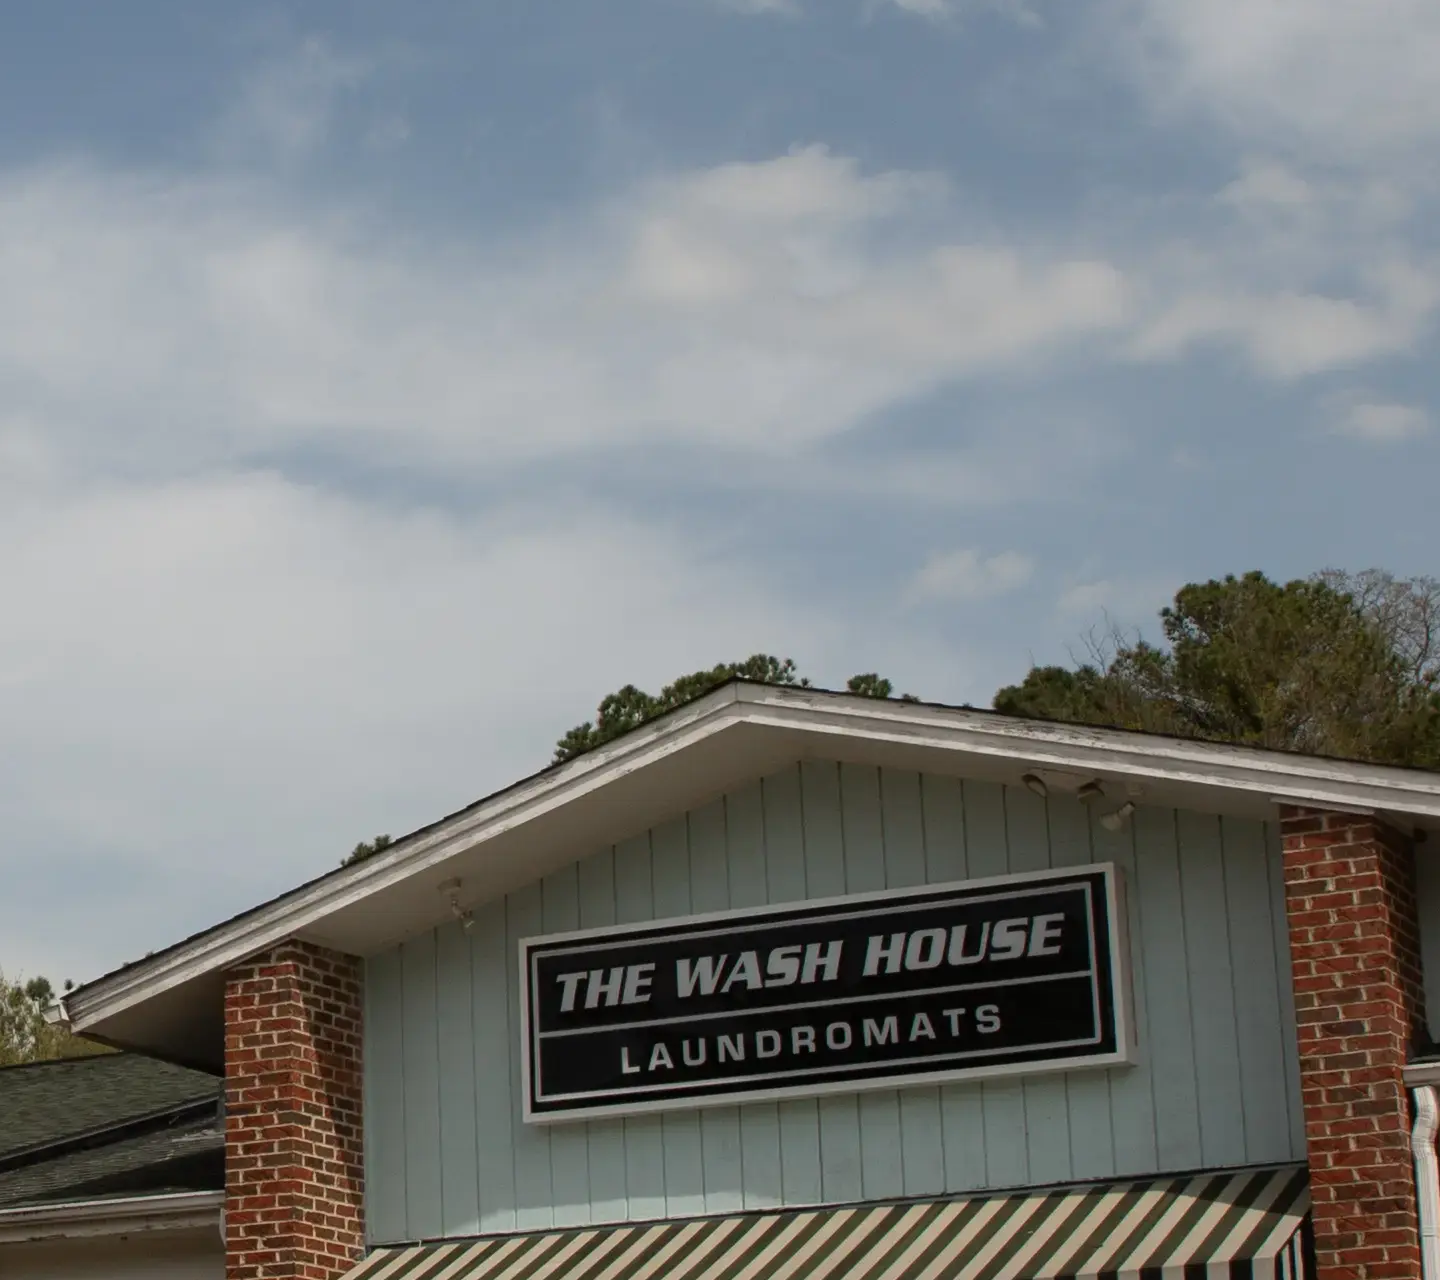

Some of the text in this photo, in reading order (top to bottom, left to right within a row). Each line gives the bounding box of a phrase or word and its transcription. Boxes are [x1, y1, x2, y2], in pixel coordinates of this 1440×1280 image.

[554, 912, 1066, 1012] THE WASH HOUSE
[620, 1004, 1002, 1075] LAUNDROMATS
